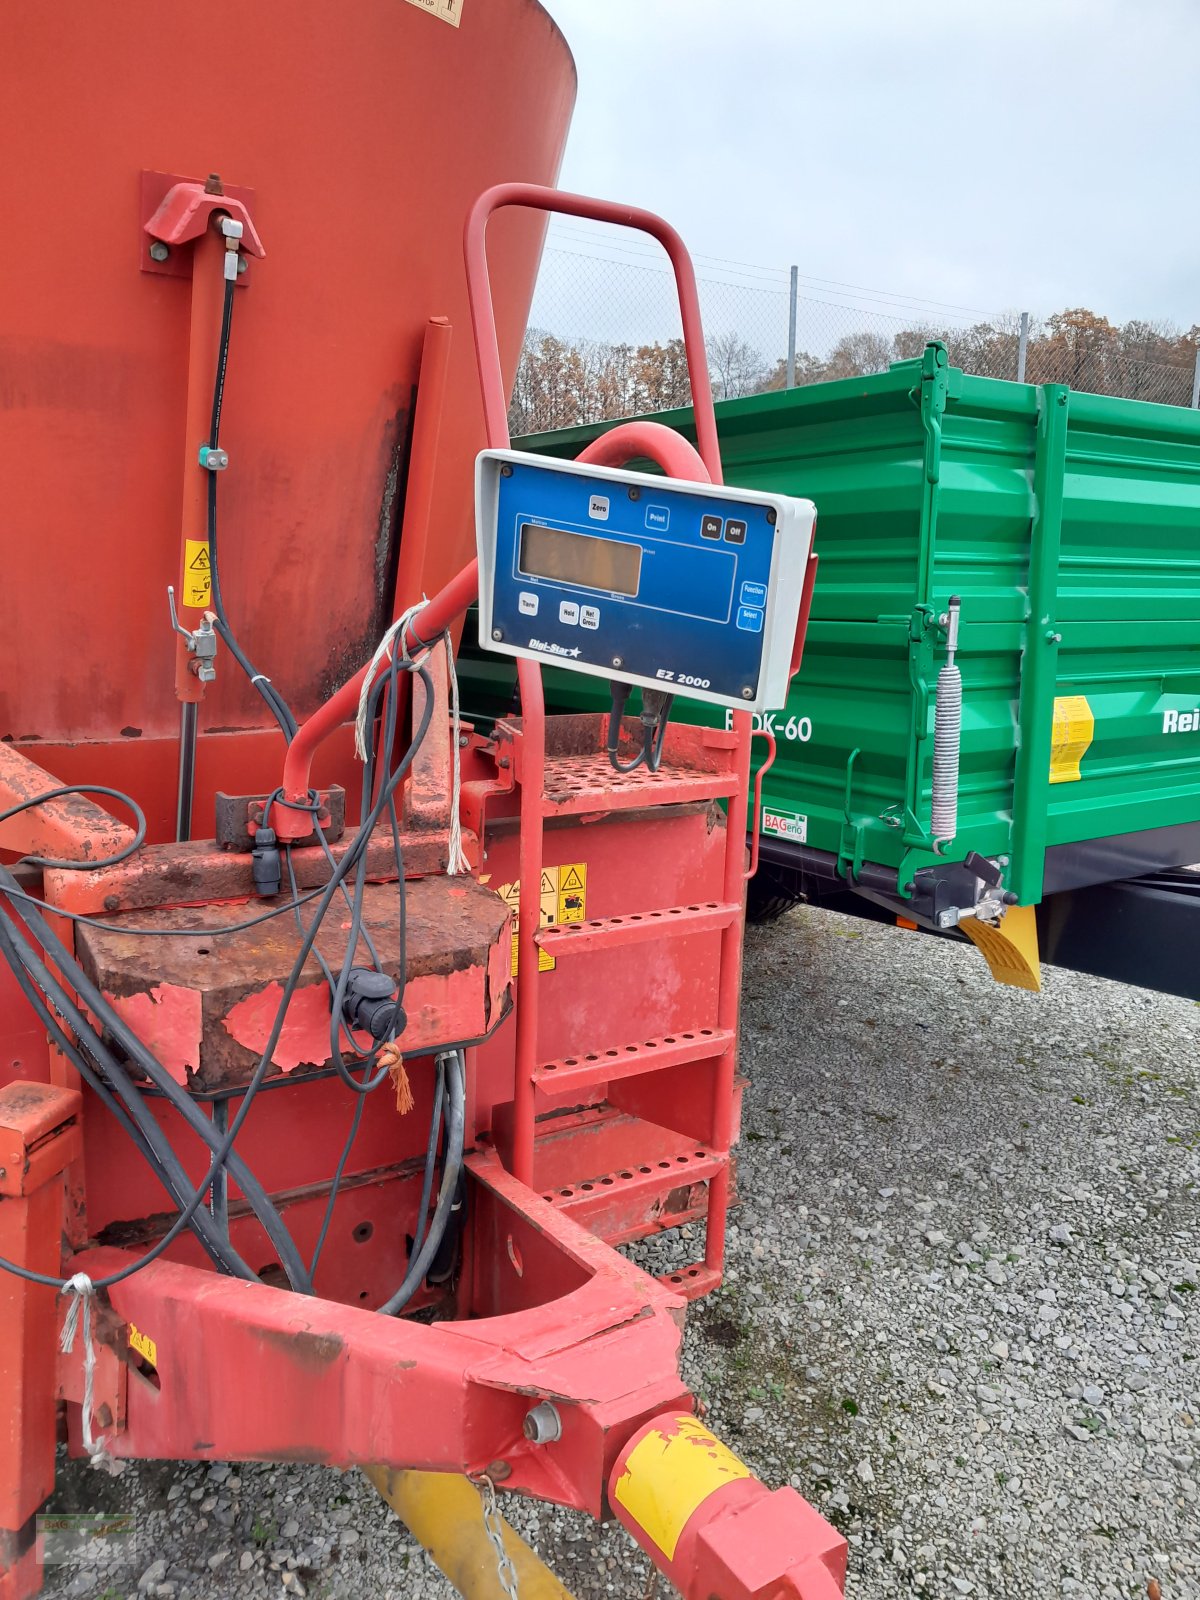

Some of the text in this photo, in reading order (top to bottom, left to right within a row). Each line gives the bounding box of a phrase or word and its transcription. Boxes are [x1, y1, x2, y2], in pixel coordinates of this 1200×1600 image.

[592, 503, 607, 512] Zero
[649, 513, 665, 523] Print
[706, 522, 717, 532] On
[729, 527, 741, 536] Off
[744, 585, 764, 595] Function
[522, 599, 536, 609] Tare
[585, 609, 595, 617] Net
[742, 610, 758, 619] Select
[582, 618, 596, 627] Gross
[528, 638, 569, 657] Digi-Star
[655, 668, 711, 689] EZ 2000
[725, 708, 812, 742] RDK-60
[1162, 708, 1200, 734] Rei
[764, 814, 803, 835] BAGeno
